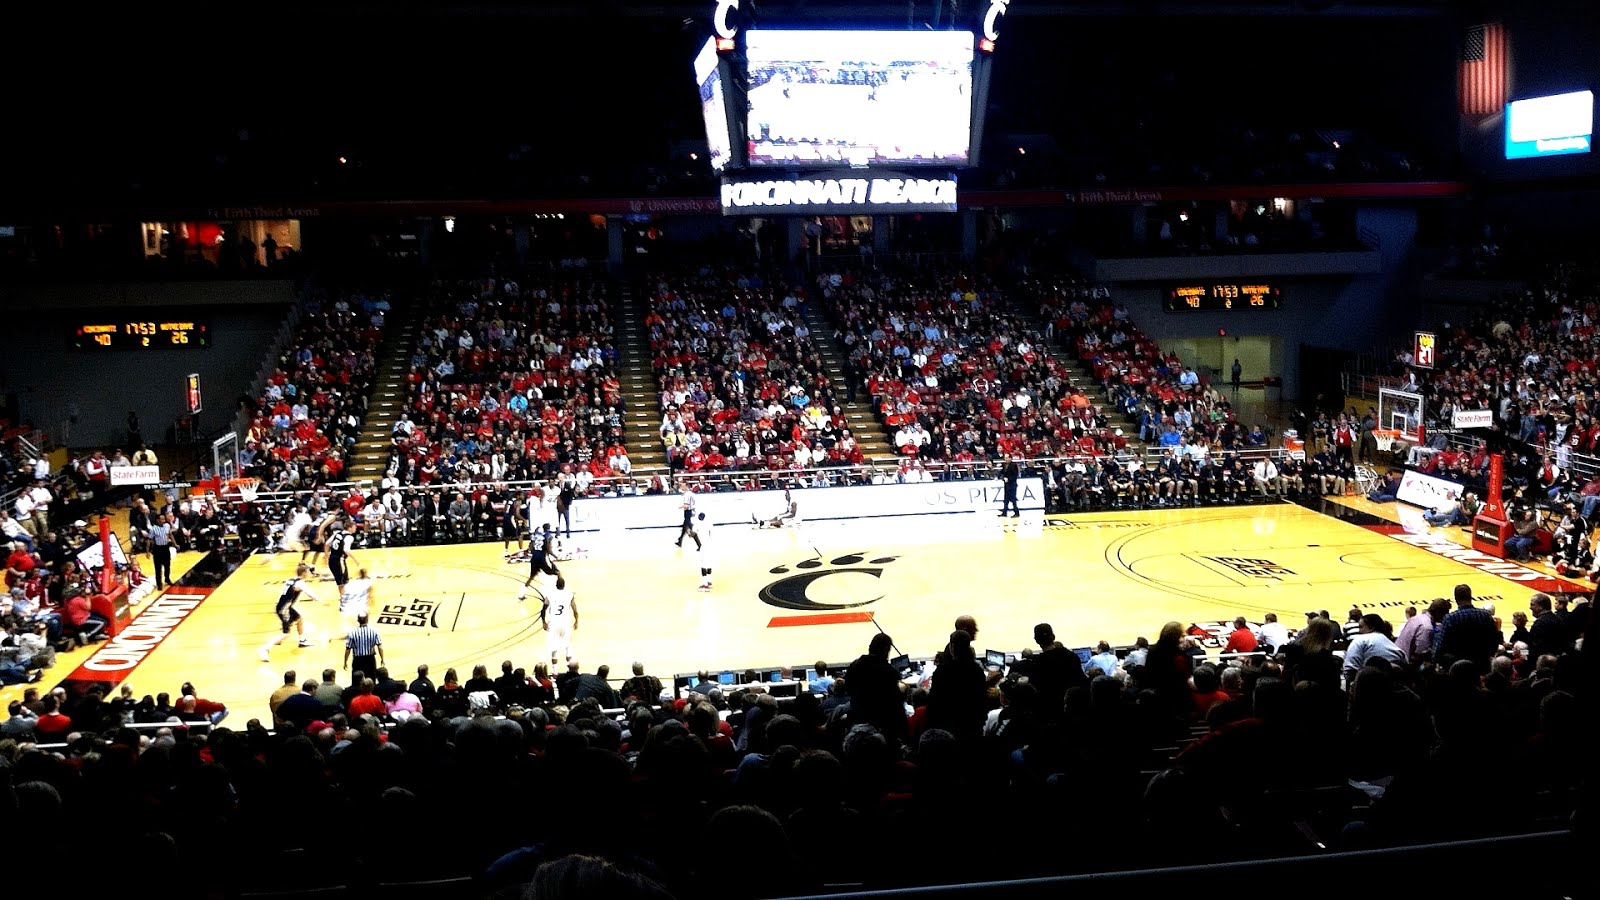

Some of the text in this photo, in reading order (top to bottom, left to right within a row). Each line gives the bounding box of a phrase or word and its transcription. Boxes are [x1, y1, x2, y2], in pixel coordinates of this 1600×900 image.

[648, 199, 704, 212] University
[1185, 296, 1200, 308] 40
[1250, 295, 1265, 306] 26
[94, 333, 112, 346] 40
[171, 331, 189, 344] 26
[1457, 414, 1491, 423] State Farm
[113, 470, 157, 480] State Farm
[967, 484, 1037, 504] PIZA
[376, 604, 407, 625] BIG
[403, 598, 434, 627] EAST
[554, 604, 565, 616] 3
